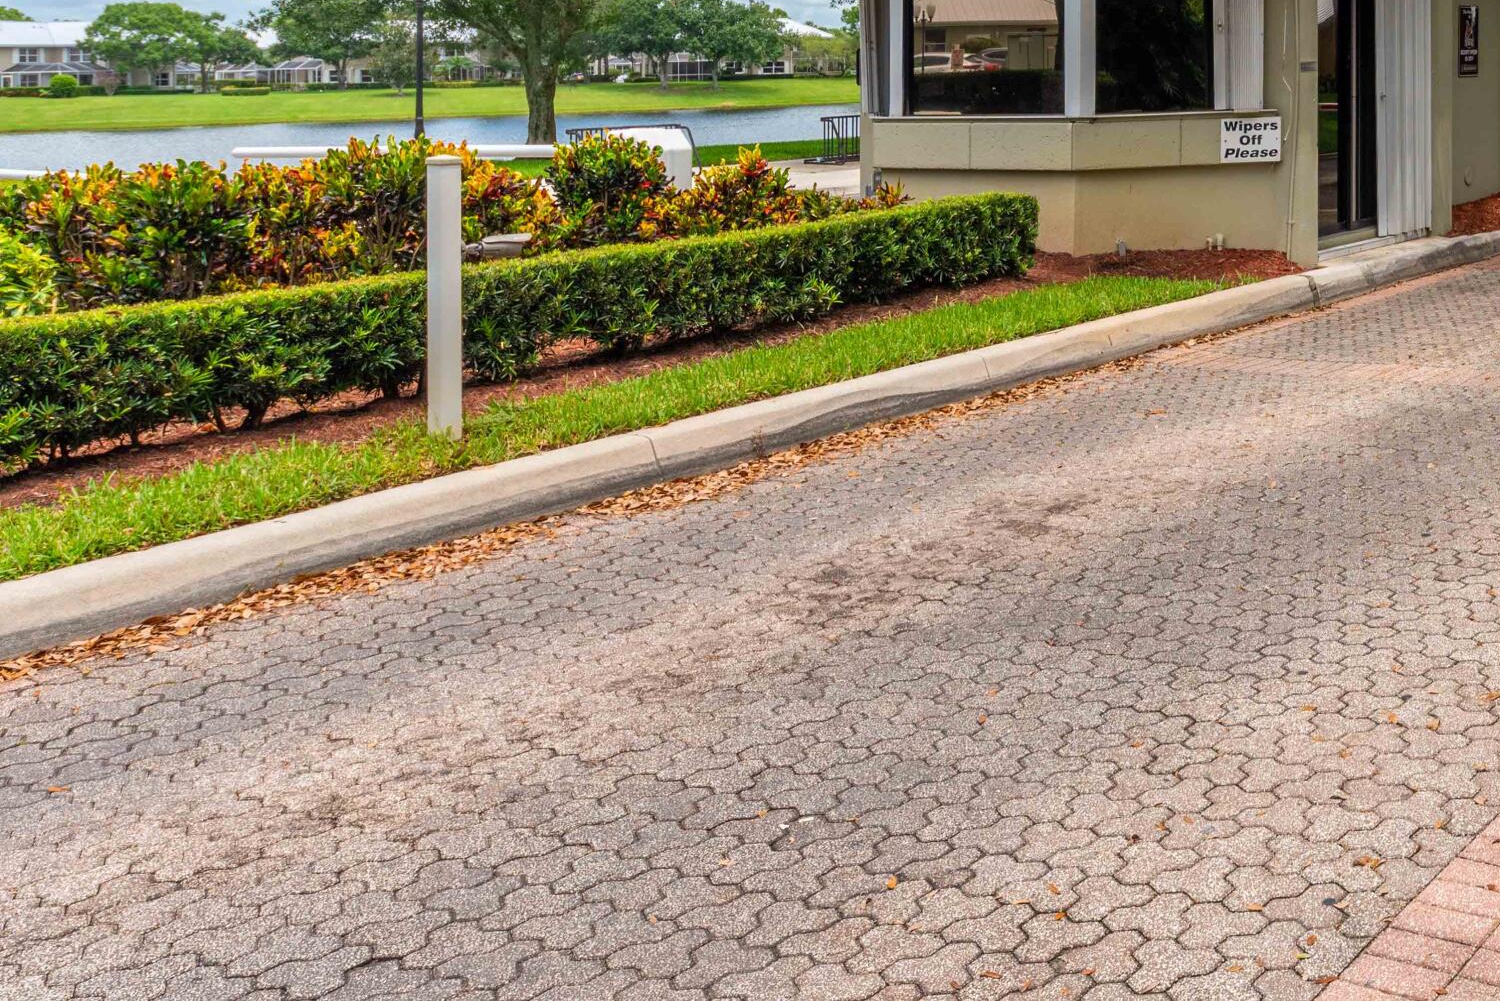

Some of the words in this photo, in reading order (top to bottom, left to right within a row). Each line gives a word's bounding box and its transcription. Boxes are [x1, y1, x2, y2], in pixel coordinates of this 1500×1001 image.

[1224, 121, 1278, 133] Wipers
[1239, 135, 1262, 146] Off
[1224, 148, 1278, 158] Please
